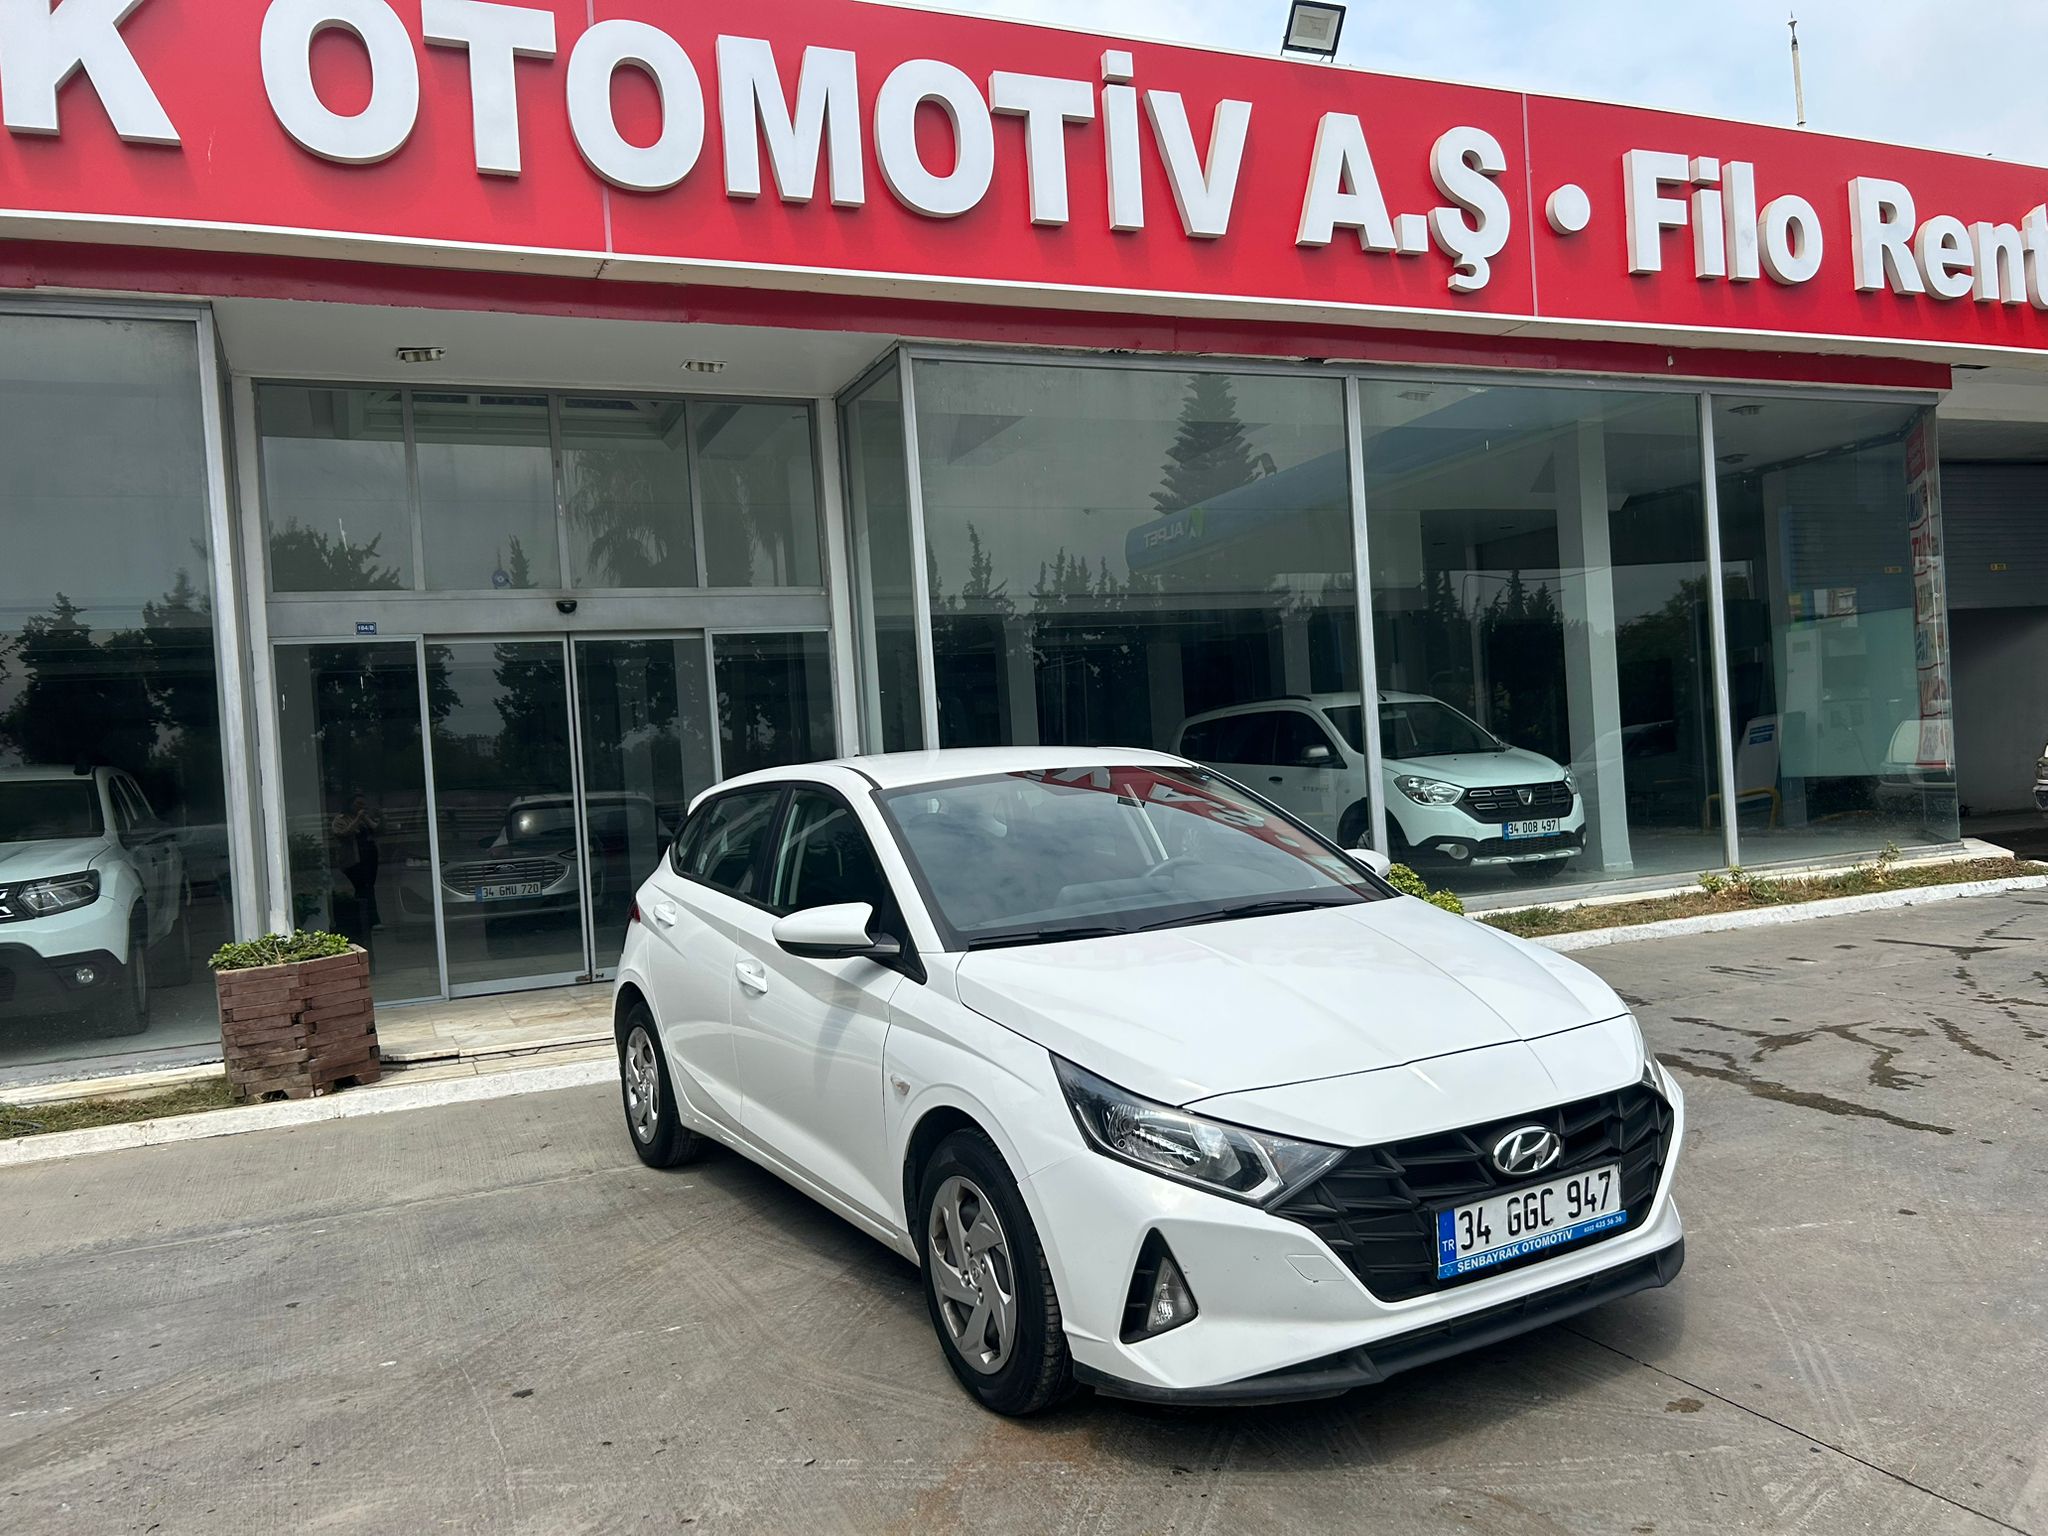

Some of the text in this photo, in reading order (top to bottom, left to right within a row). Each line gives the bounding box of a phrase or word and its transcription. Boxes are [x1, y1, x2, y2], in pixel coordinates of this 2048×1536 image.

[1622, 149, 1824, 286] Filo
[1848, 176, 2048, 310] Rent
[1508, 822, 1519, 835] 34
[1541, 819, 1556, 831] 497
[482, 887, 494, 898] 34
[521, 883, 539, 894] 720
[1458, 1169, 1611, 1251] 34 GGC 947
[1442, 1238, 1455, 1252] TR
